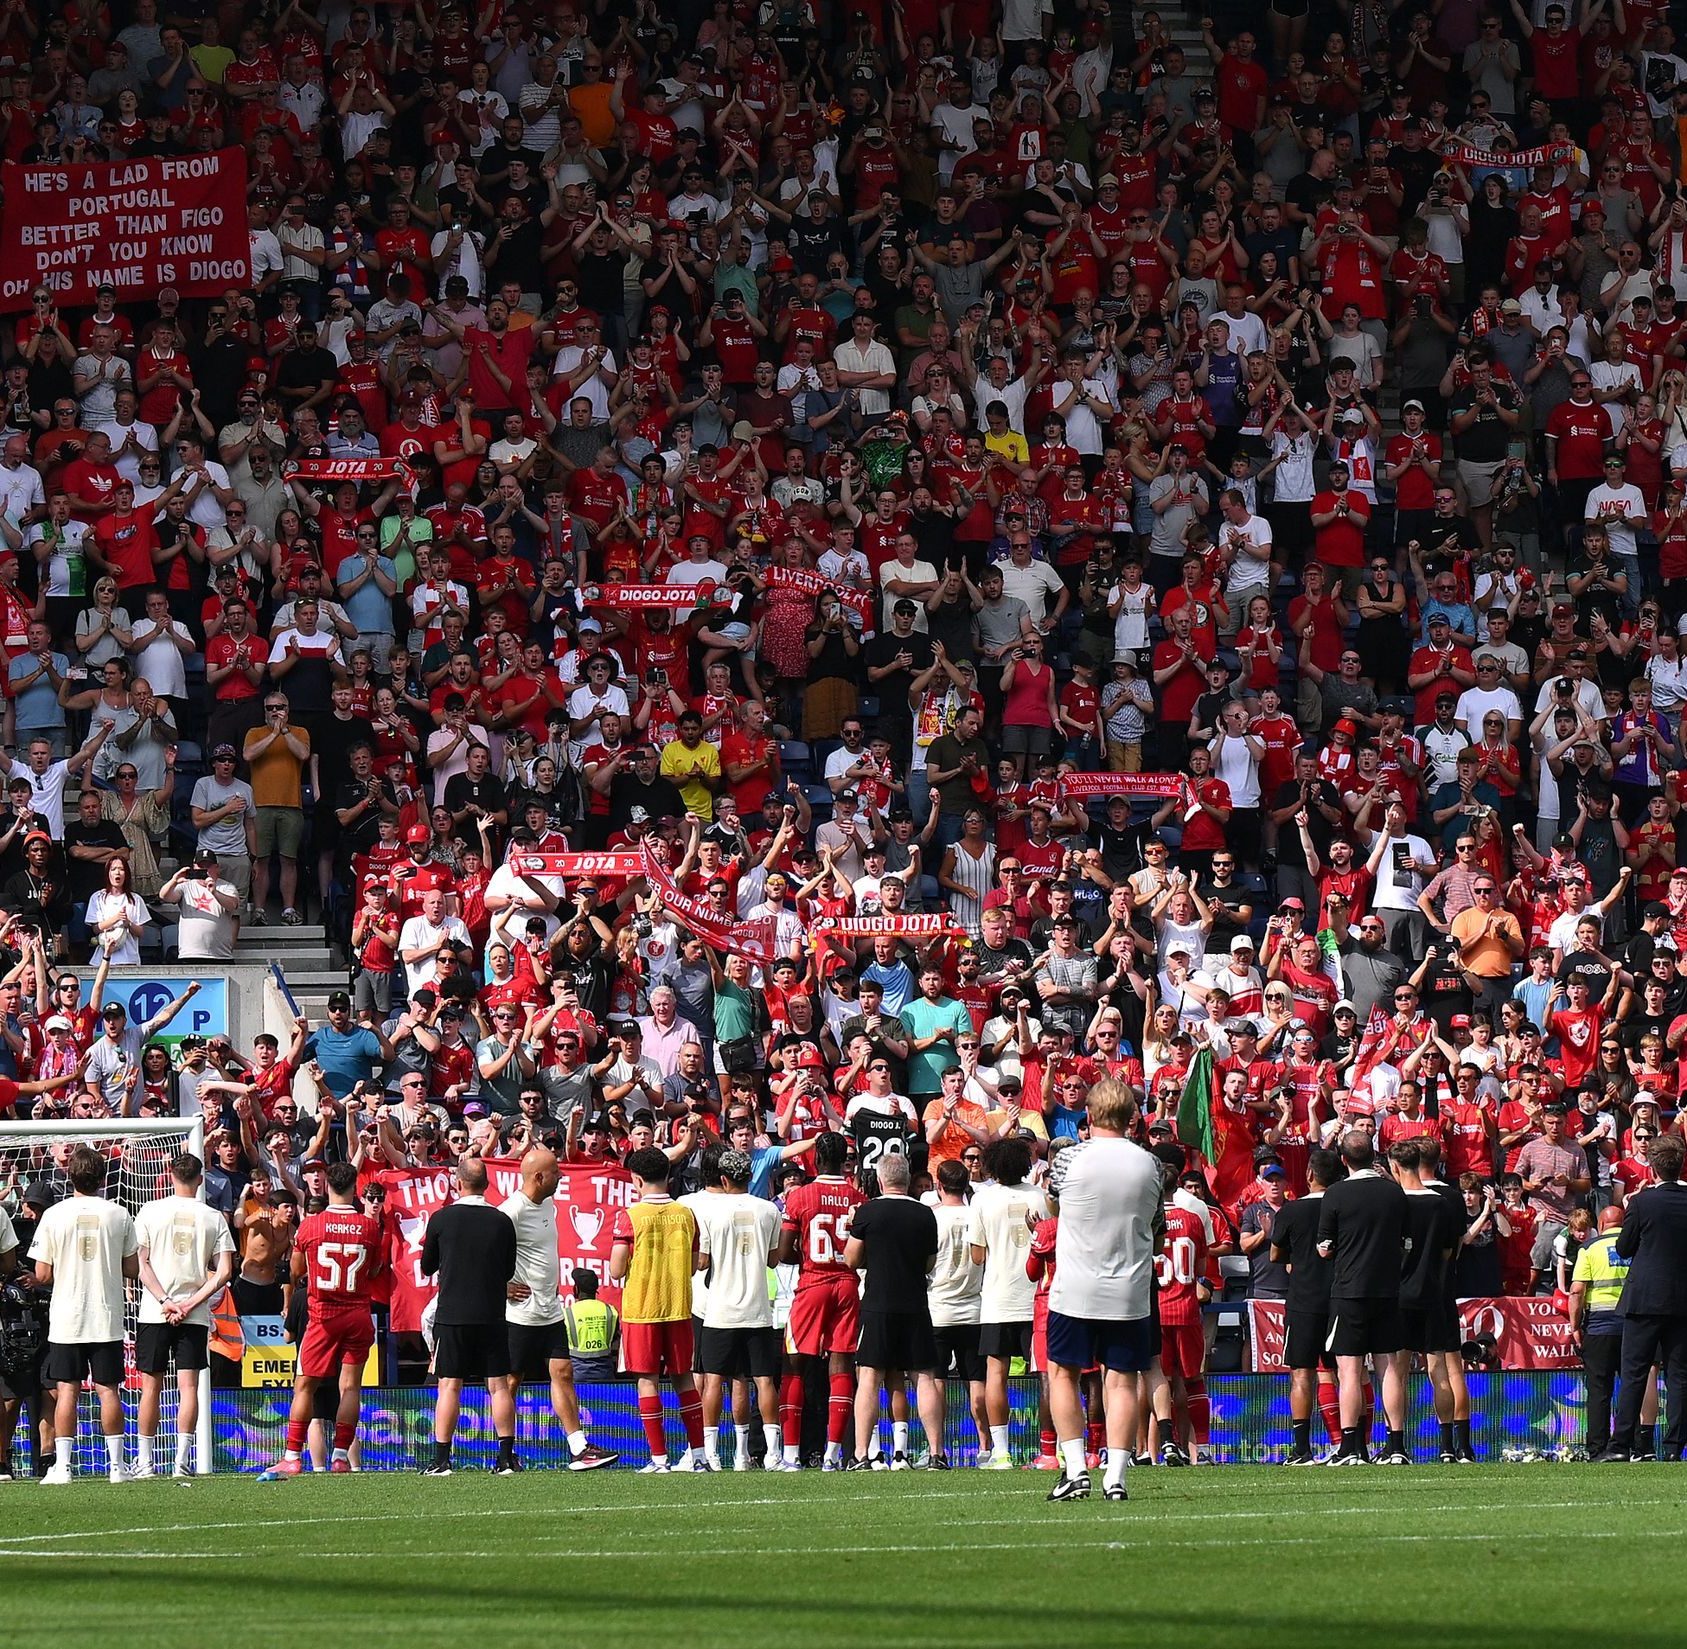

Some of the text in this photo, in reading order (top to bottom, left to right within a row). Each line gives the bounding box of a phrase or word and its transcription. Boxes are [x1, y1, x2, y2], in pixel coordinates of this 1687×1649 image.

[1464, 148, 1544, 166] DIOGO JOTA
[24, 156, 220, 193] HE'S A LAD FROM
[68, 189, 175, 217] PORTUGAL
[21, 206, 224, 246] BETTER THAN FIGO
[36, 235, 214, 270] DON'T YOU KNOW
[3, 259, 246, 298] OH HIS NAME IS DIOGO
[308, 460, 383, 474] 20 JOTA 20
[1599, 500, 1631, 512] NASA
[772, 567, 850, 600] LIVERPOOL
[619, 588, 696, 601] DIOGO JOTA
[1140, 653, 1150, 662] 20
[1066, 774, 1177, 785] YOU'LL NEVER WALK ALONE
[555, 857, 635, 870] 20 JOTA 20
[1022, 865, 1058, 876] Candy
[664, 888, 772, 928] OUR NUMBER 20
[841, 914, 942, 931] DIOGO JOTA
[193, 1010, 211, 1031] P
[870, 1120, 893, 1130] DIOGO
[862, 1136, 902, 1170] 20
[401, 1179, 459, 1209] THOS
[592, 1175, 640, 1207] THE
[820, 1194, 849, 1207] NALLO
[325, 1221, 362, 1235] KERKEZ
[316, 1241, 367, 1293] 57
[1530, 1324, 1574, 1337] NEVE
[585, 1339, 603, 1350] 026
